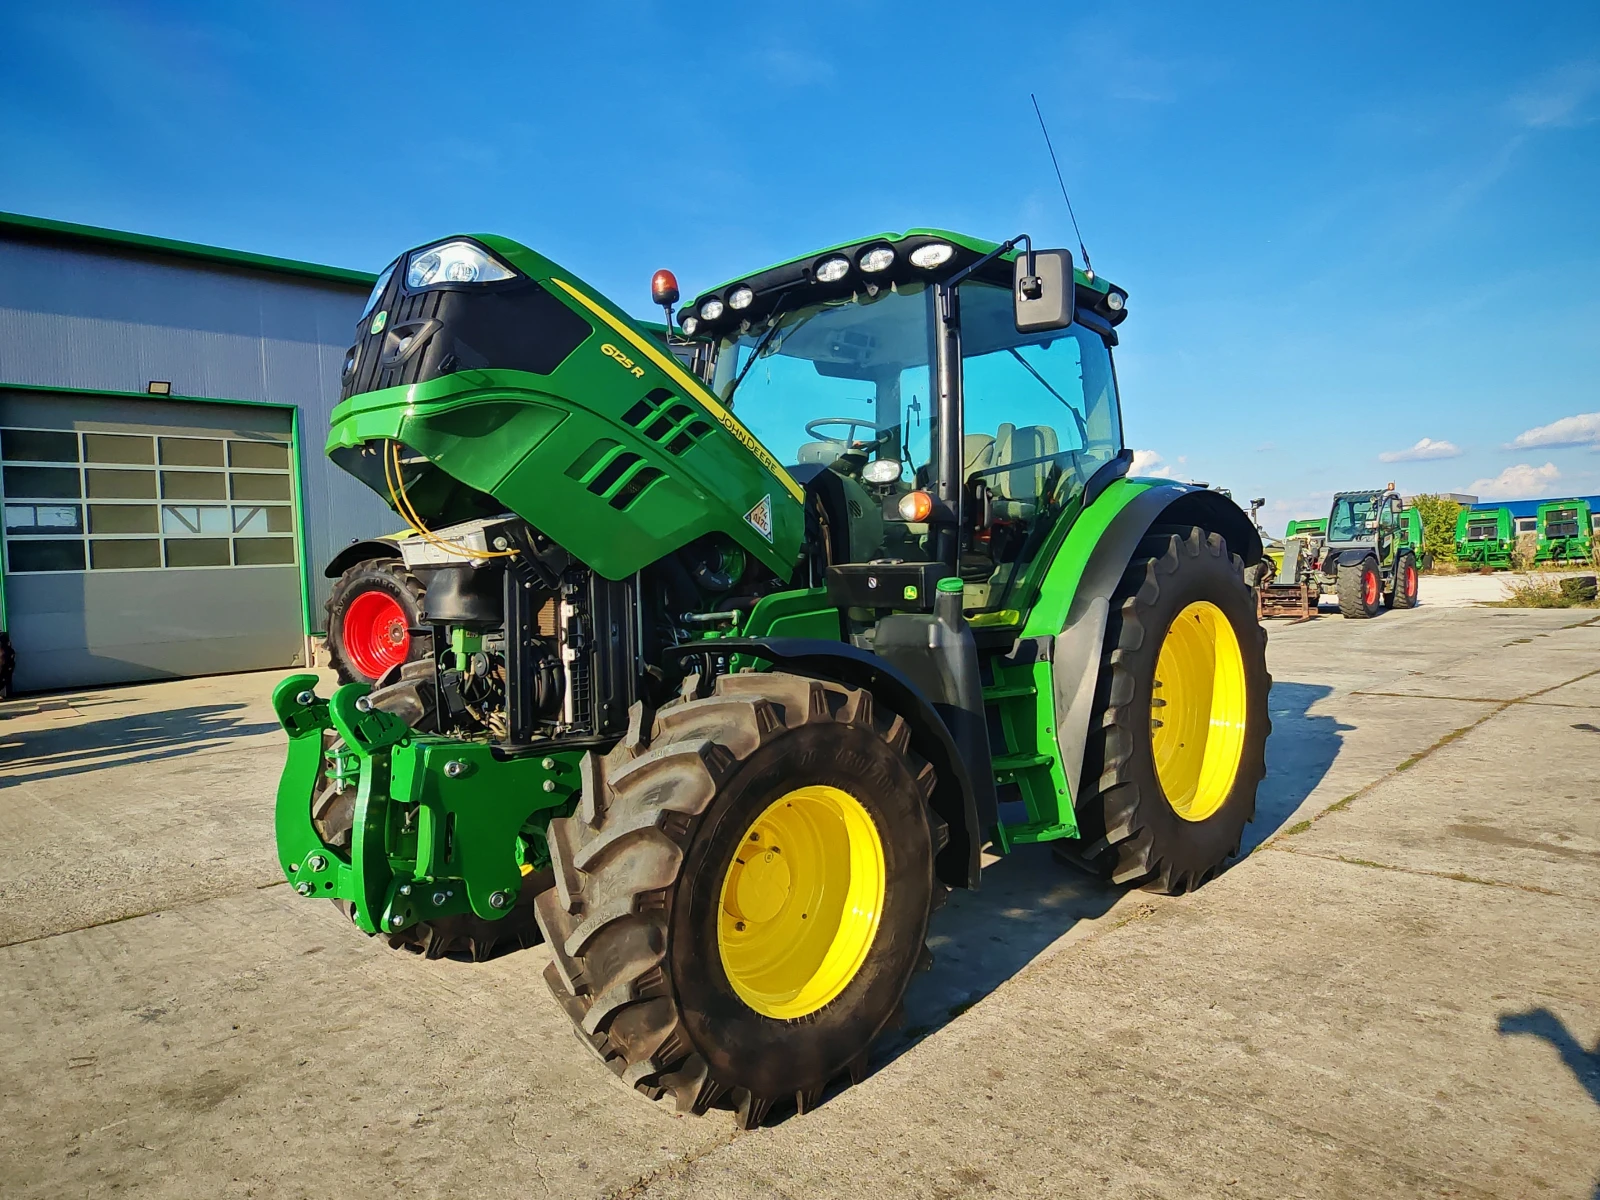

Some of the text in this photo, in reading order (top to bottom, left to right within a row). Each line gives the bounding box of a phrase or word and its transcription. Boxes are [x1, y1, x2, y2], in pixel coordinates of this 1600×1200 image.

[600, 343, 645, 379] 6125 R
[717, 412, 778, 474] JOHN DEERE
